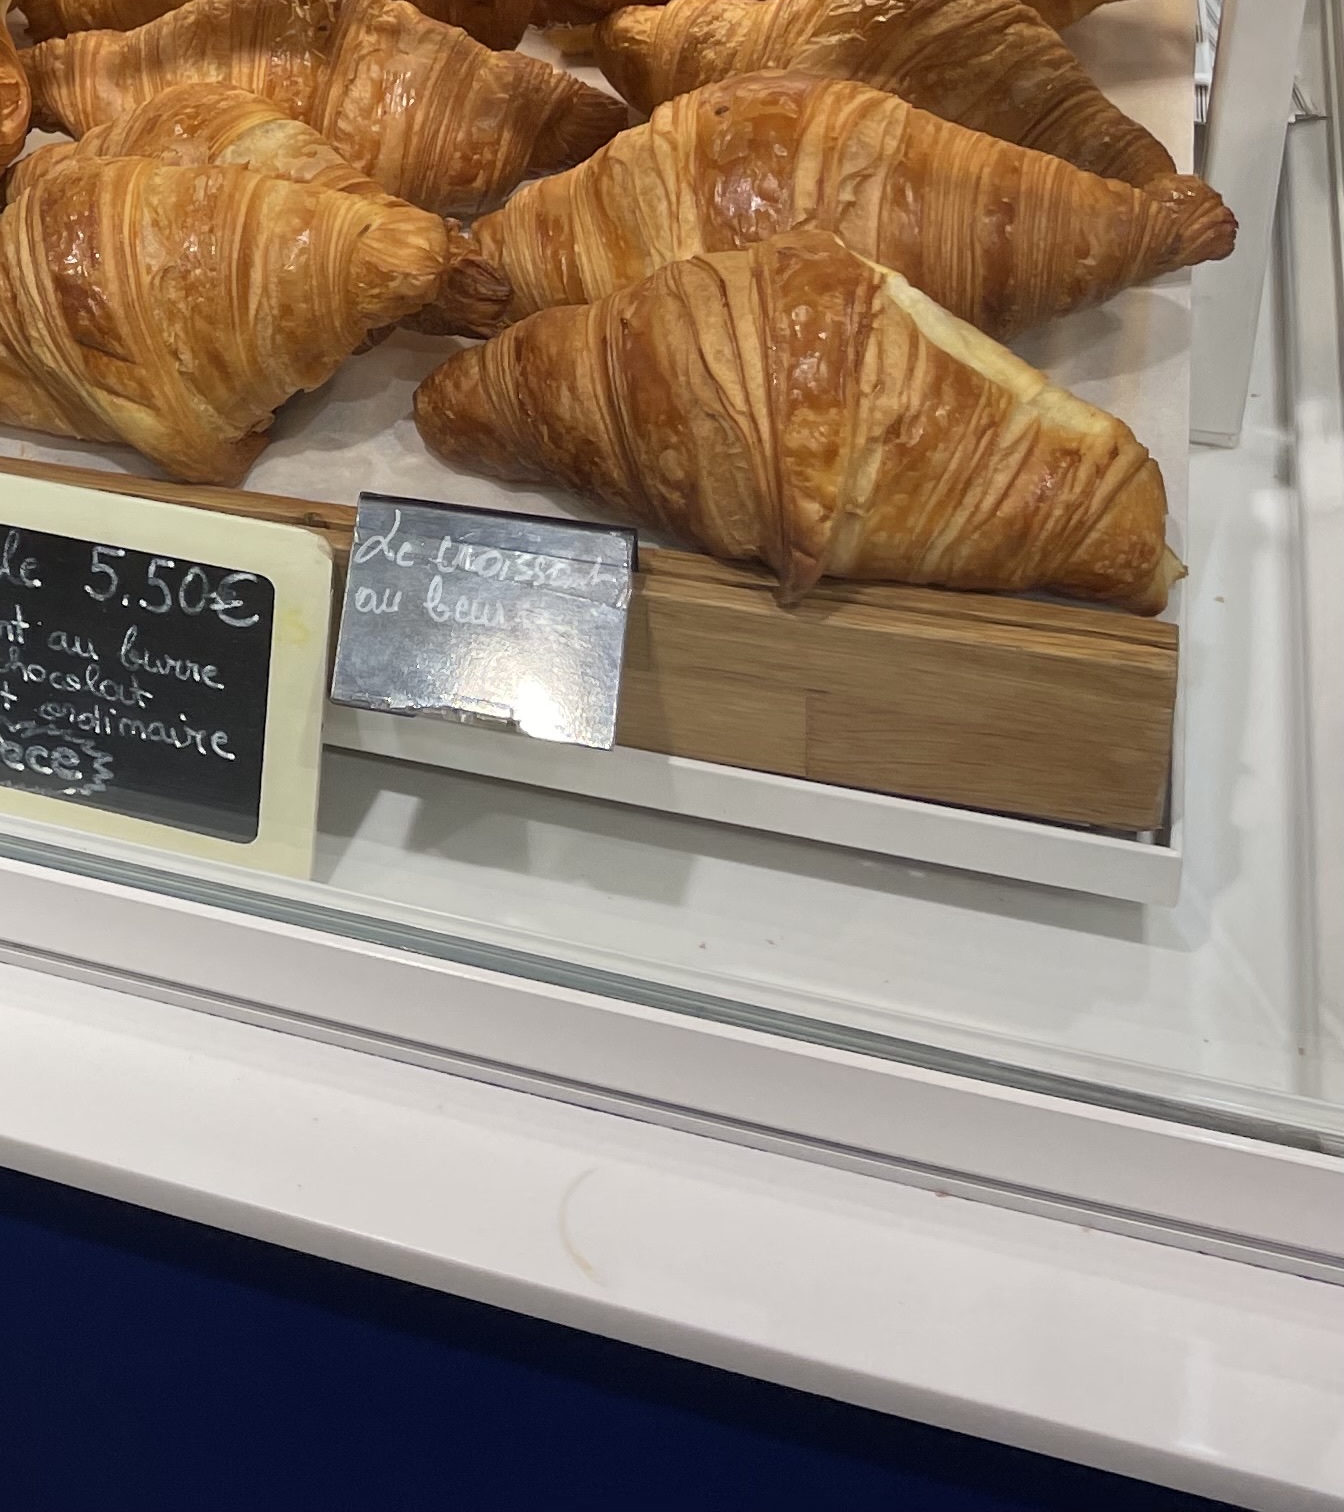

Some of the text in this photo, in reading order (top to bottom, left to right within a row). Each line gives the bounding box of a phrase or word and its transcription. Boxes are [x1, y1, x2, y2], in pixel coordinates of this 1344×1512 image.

[353, 508, 416, 568] Le
[354, 585, 404, 615] au
[46, 629, 100, 662] au
[36, 702, 238, 762] ordinaire
